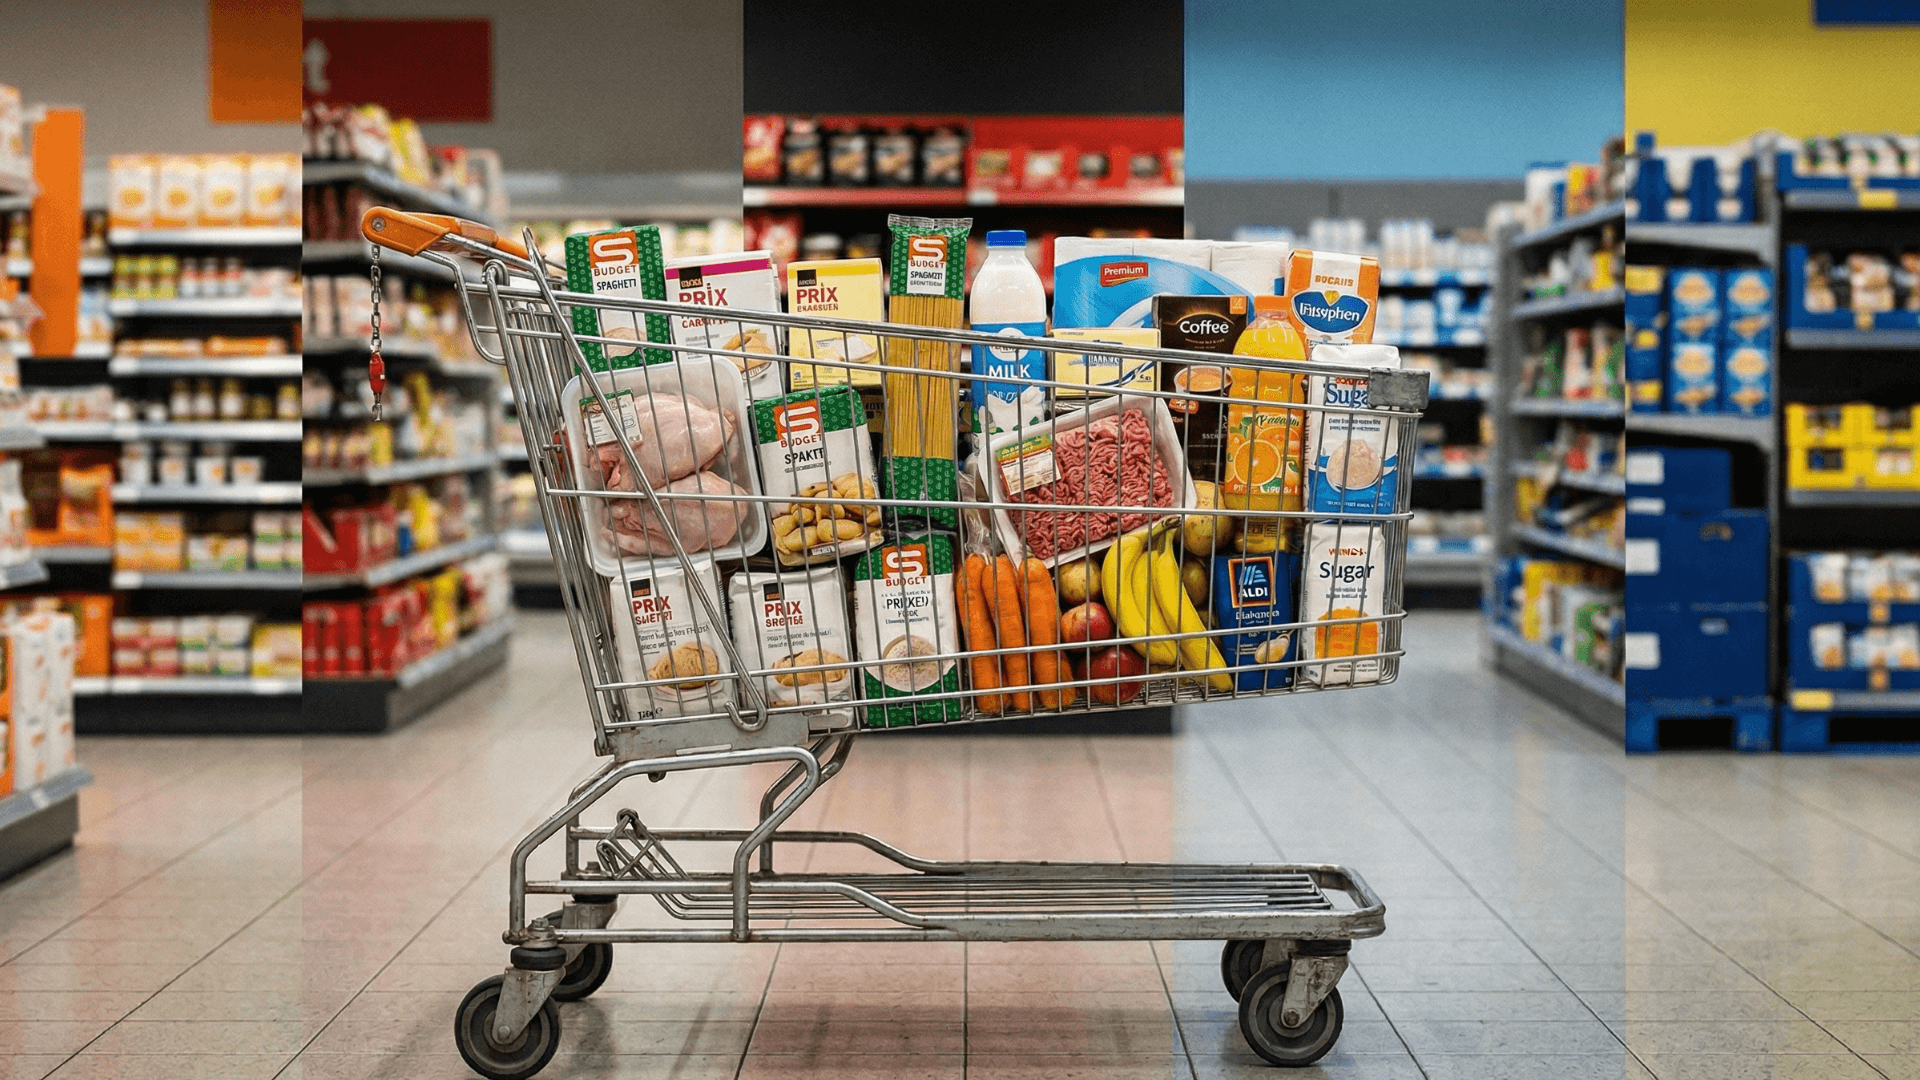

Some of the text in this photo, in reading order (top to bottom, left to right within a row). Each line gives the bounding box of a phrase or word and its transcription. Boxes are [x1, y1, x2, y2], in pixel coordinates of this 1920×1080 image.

[594, 265, 637, 276] BUDGET
[1104, 266, 1144, 275] Premium
[988, 364, 1031, 378] MILK
[1323, 383, 1368, 408] Suga
[780, 434, 822, 448] BUDGET
[1319, 561, 1375, 583] Sugar
[885, 576, 927, 587] BUDGET
[1239, 587, 1269, 598] ALDI
[632, 595, 672, 615] PRIX
[764, 600, 803, 618] PRIX
